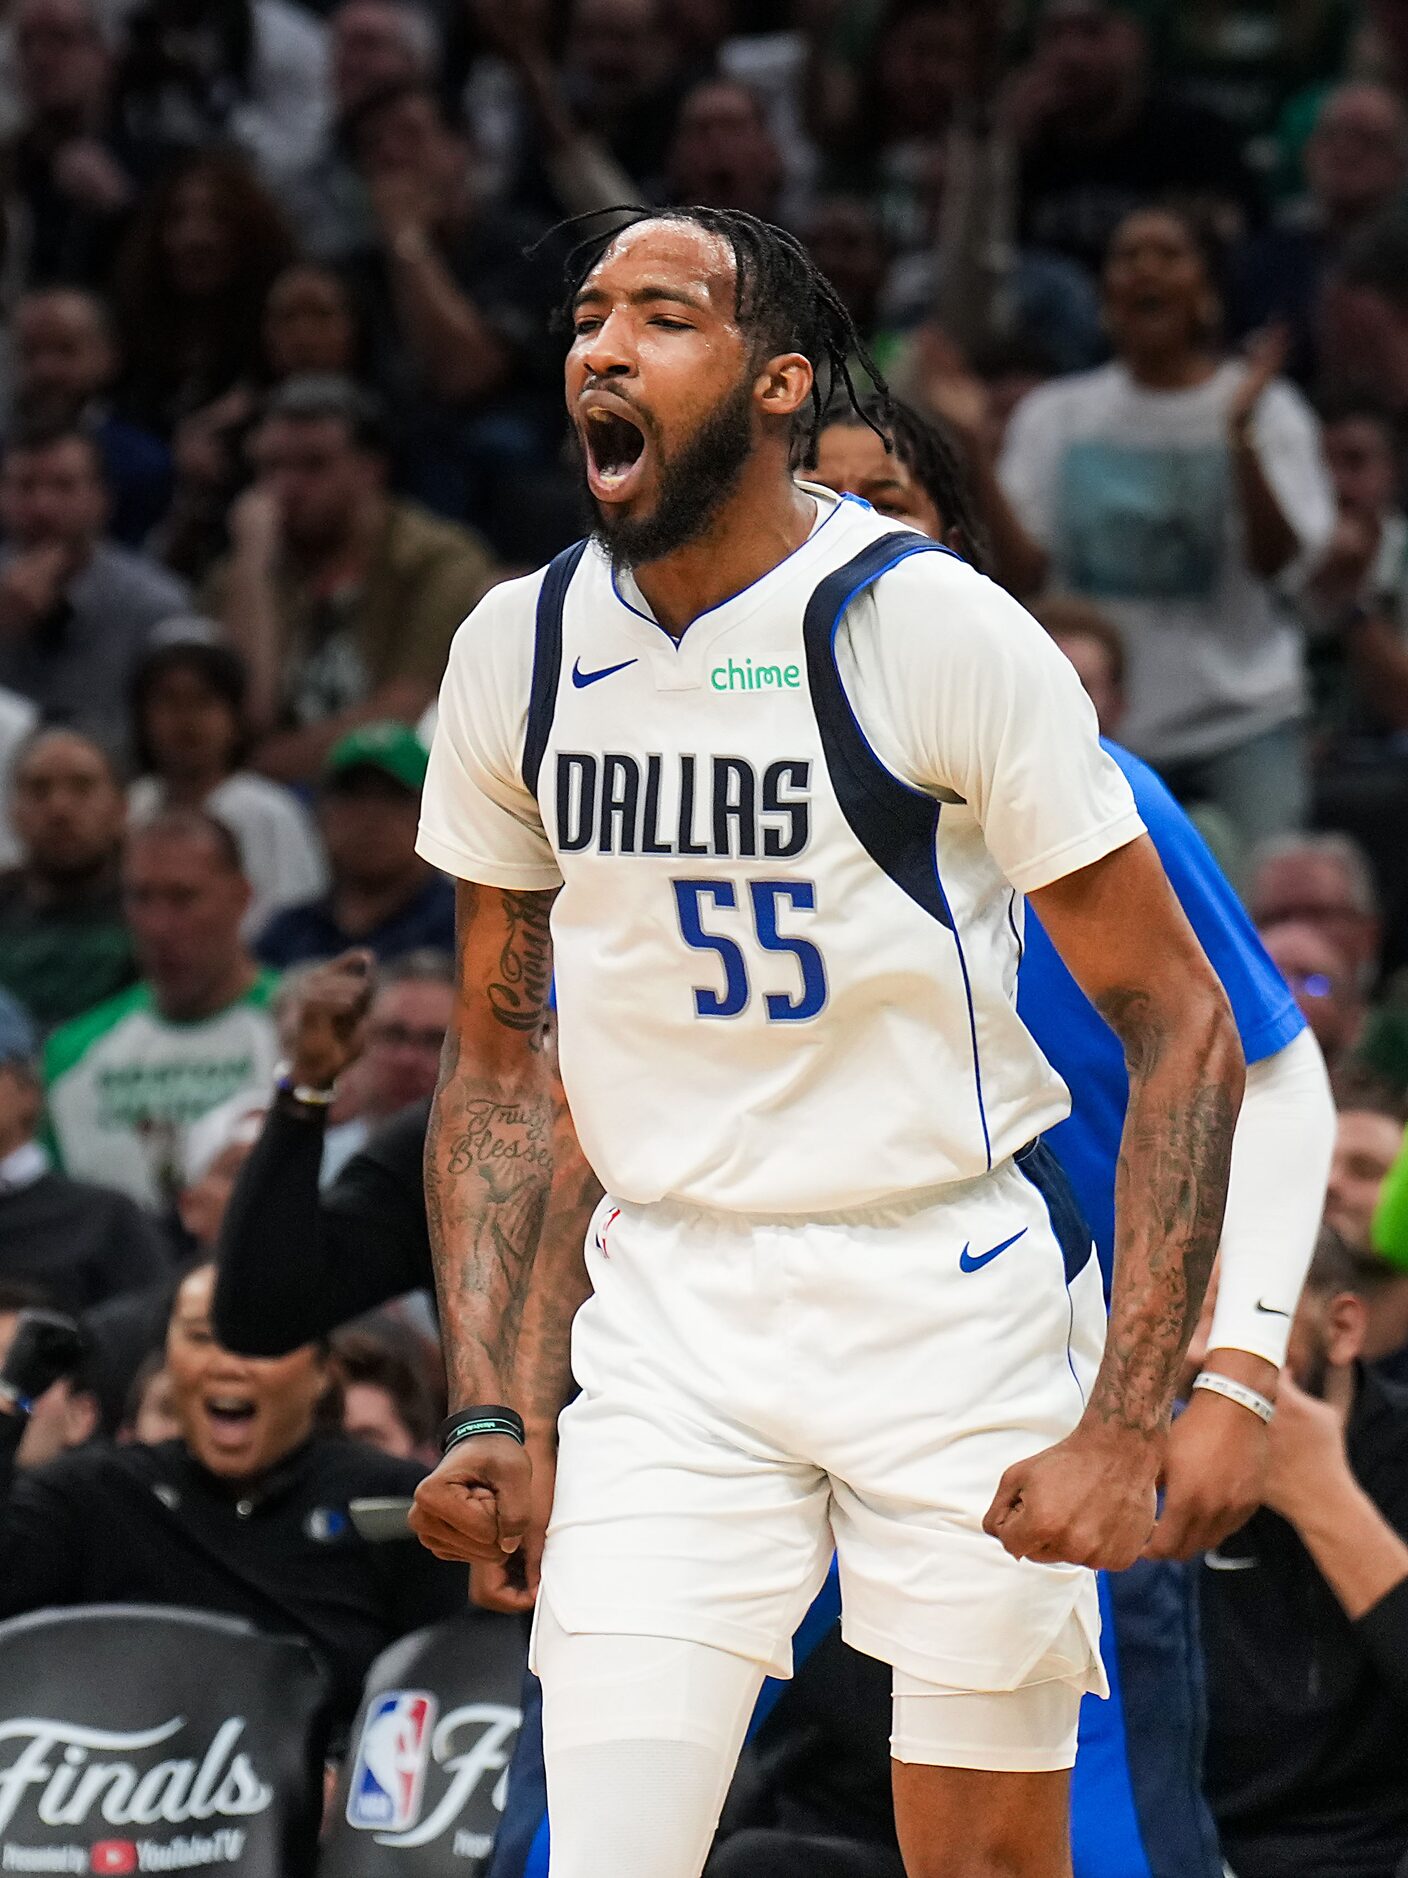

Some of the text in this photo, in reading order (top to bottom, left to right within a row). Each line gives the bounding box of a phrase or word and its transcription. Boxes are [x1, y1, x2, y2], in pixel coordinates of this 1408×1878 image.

[711, 658, 800, 690] chime
[555, 750, 813, 861] DALLAS
[669, 877, 829, 1024] 55
[0, 1714, 274, 1836] Finals
